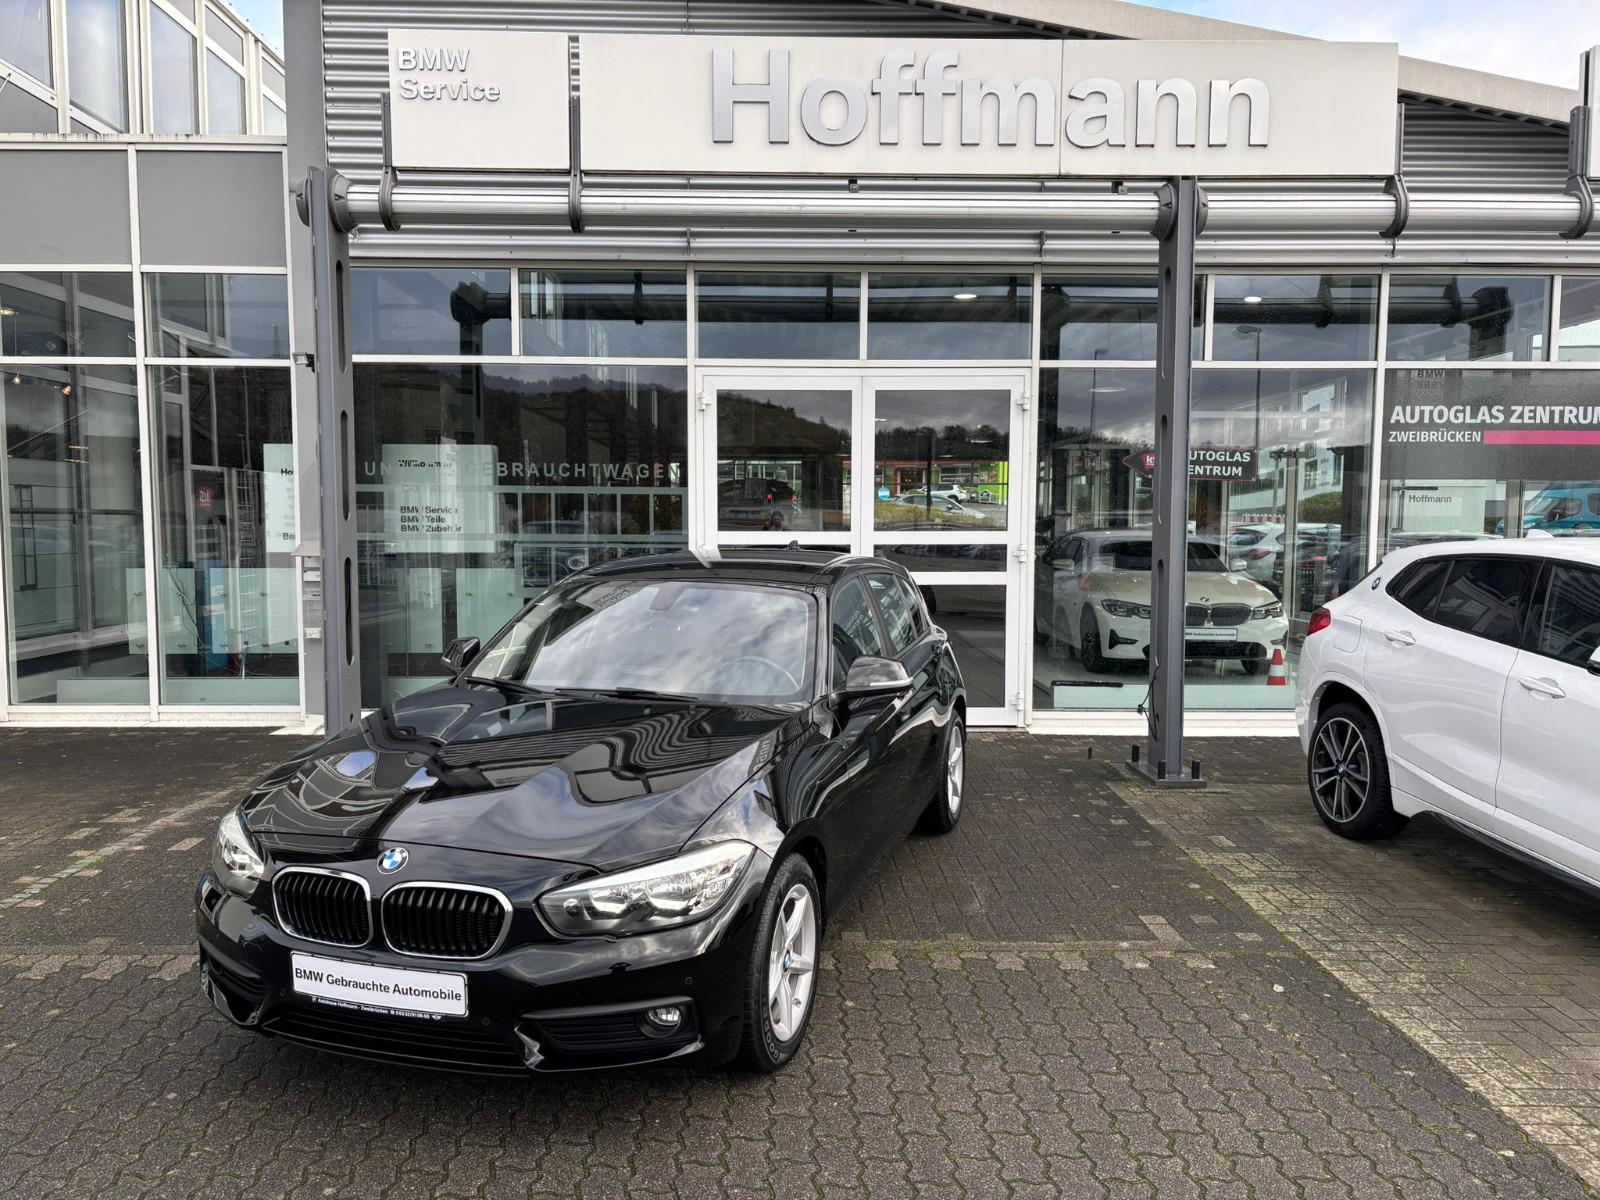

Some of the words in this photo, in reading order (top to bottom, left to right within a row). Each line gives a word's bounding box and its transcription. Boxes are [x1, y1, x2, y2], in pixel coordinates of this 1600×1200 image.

[397, 47, 470, 71] BMW
[399, 78, 501, 102] Service
[711, 47, 1271, 149] Hoffmann
[1390, 405, 1505, 424] AUTOGLAS
[1388, 428, 1482, 443] ZWEIBRÜCKEN
[1189, 451, 1250, 461] UTOGLAS
[1189, 466, 1242, 476] ENTRUM
[1408, 494, 1452, 504] Hoffmann
[295, 967, 324, 983] BMW
[326, 973, 390, 993] Gebrauchte
[392, 983, 462, 1002] Automobile
